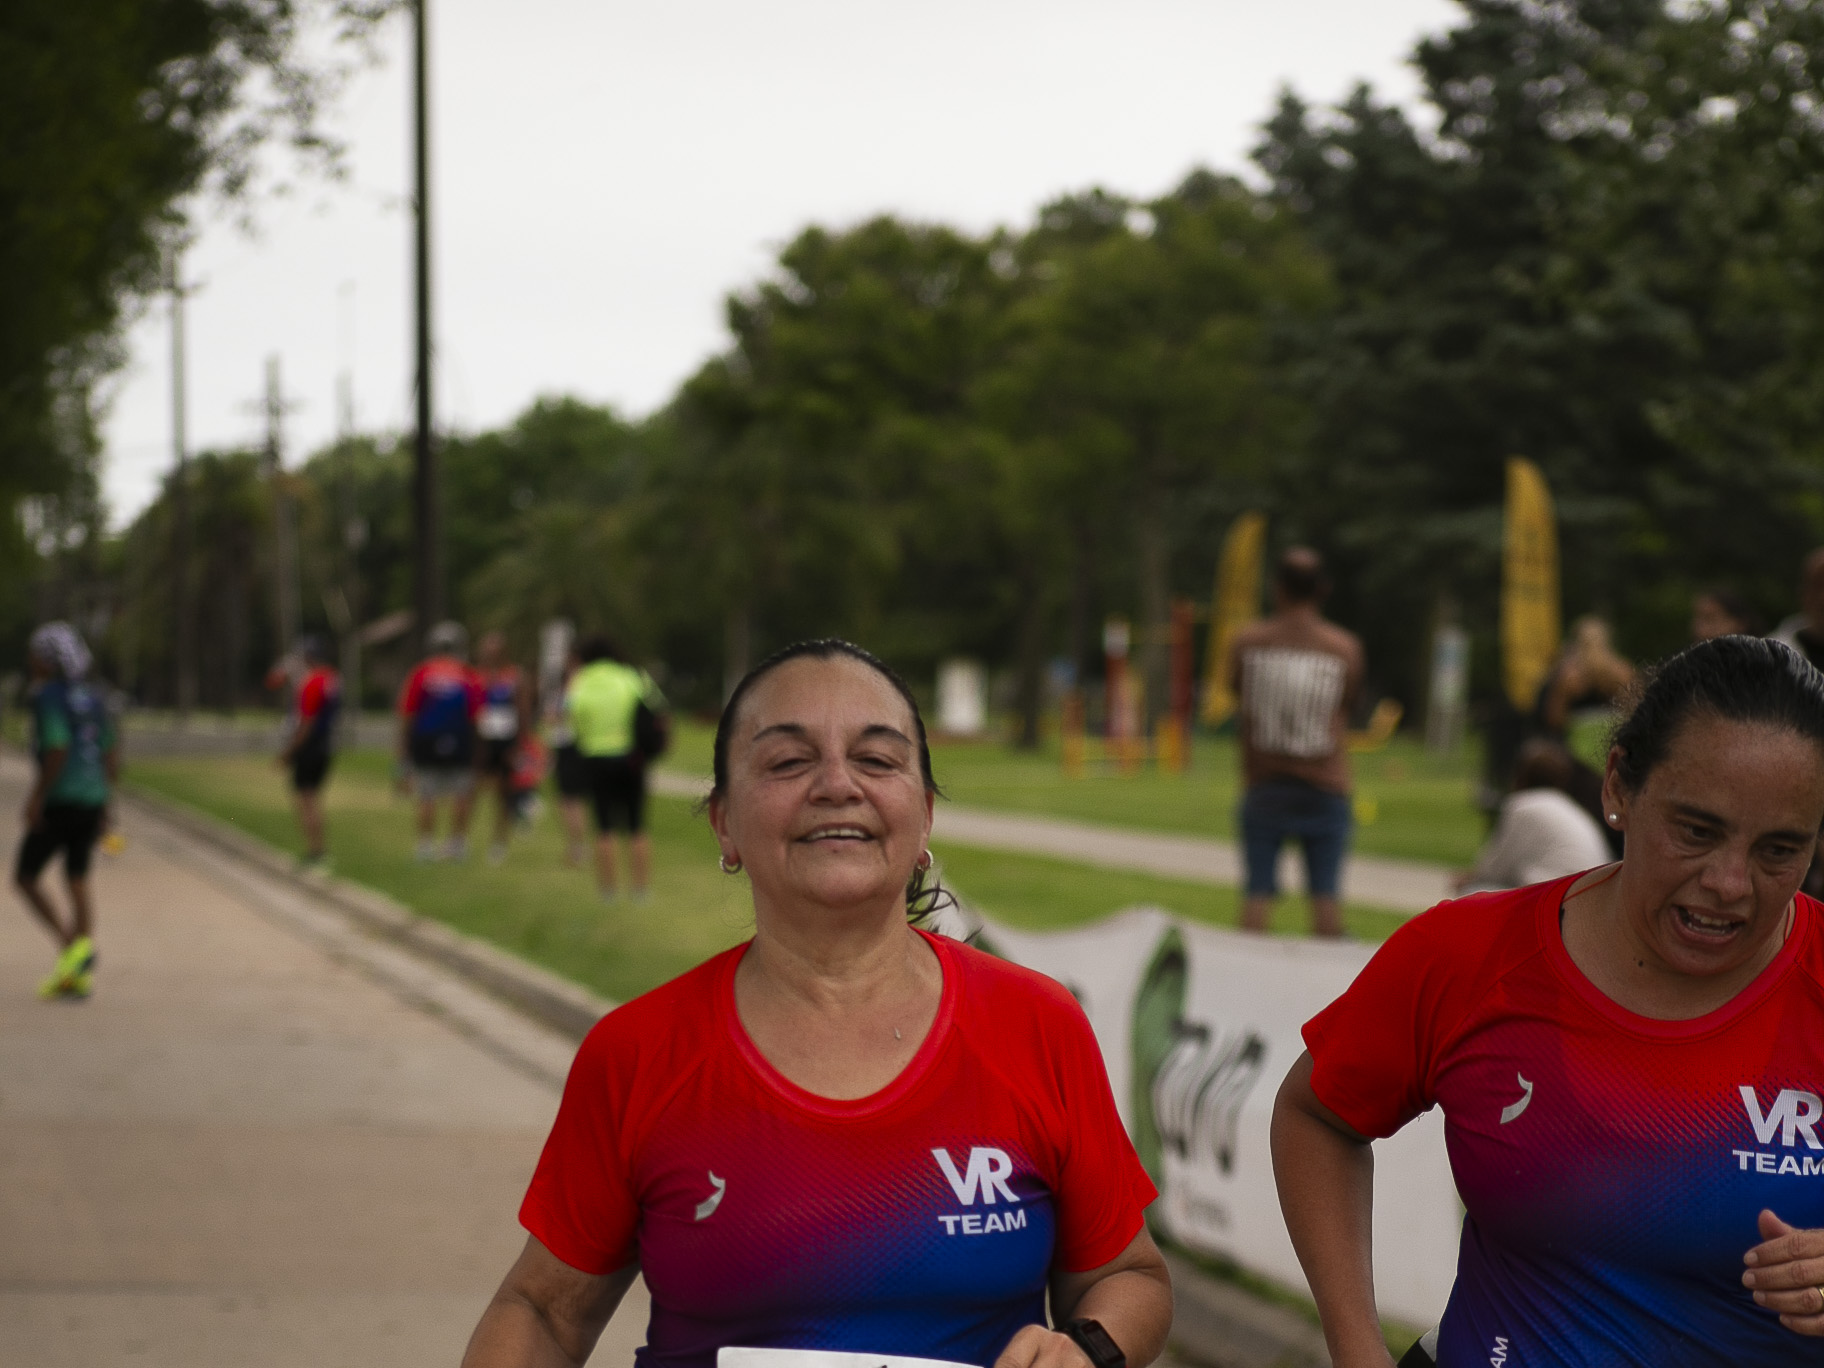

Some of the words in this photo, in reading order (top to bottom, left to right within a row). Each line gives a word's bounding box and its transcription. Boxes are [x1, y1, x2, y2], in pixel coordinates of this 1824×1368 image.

[1738, 1085, 1824, 1150] VR
[930, 1146, 1021, 1206] VR
[1732, 1149, 1824, 1176] TEAM
[938, 1208, 1027, 1235] TEAM
